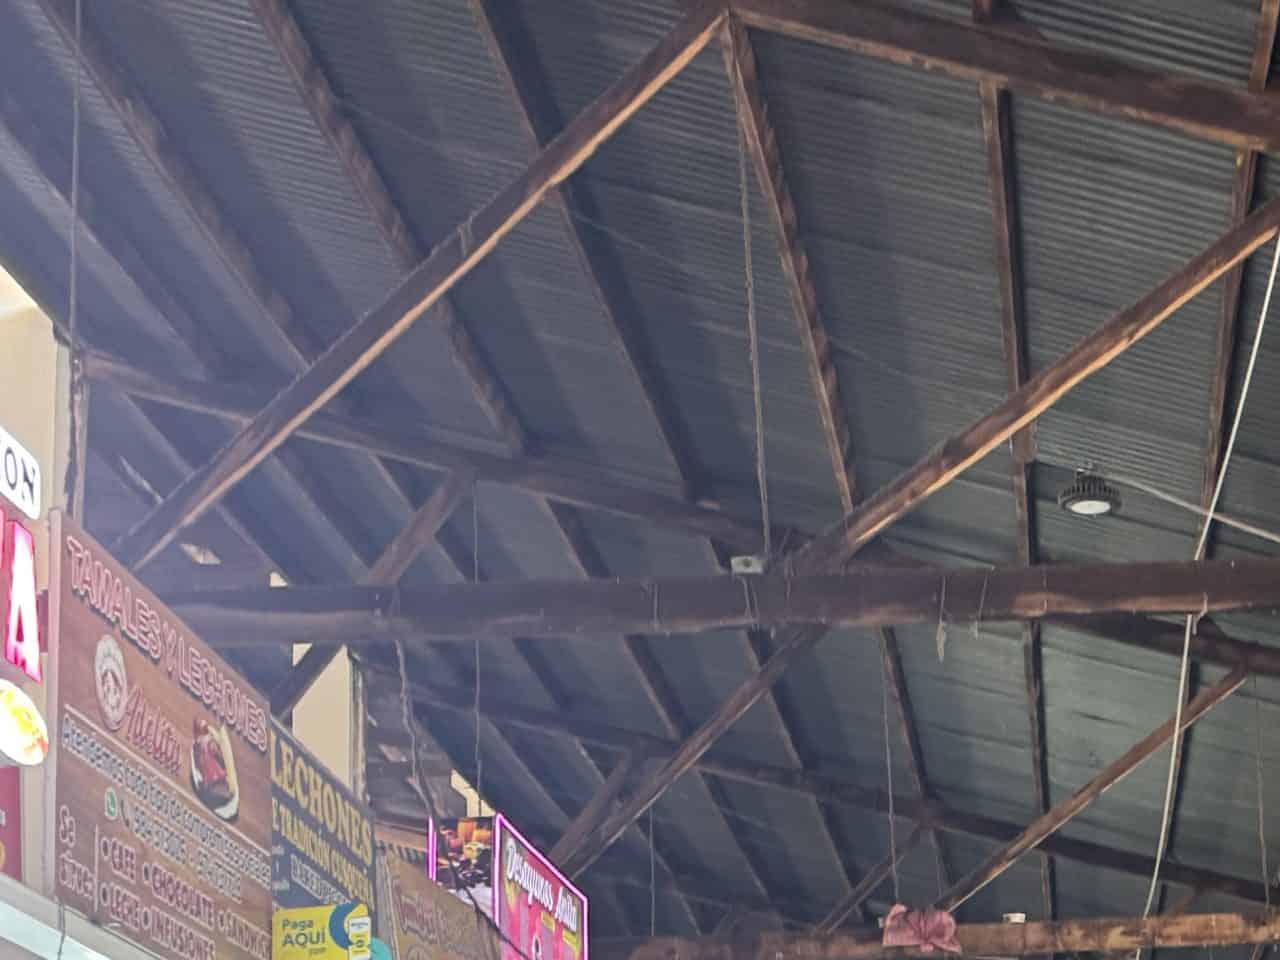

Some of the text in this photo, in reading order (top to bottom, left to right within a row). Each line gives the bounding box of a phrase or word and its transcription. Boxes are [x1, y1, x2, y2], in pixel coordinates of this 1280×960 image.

[67, 535, 162, 660] TAMALES
[179, 635, 269, 753] LECHONES
[271, 732, 371, 866] LECHONES
[506, 837, 554, 912] Desayunos
